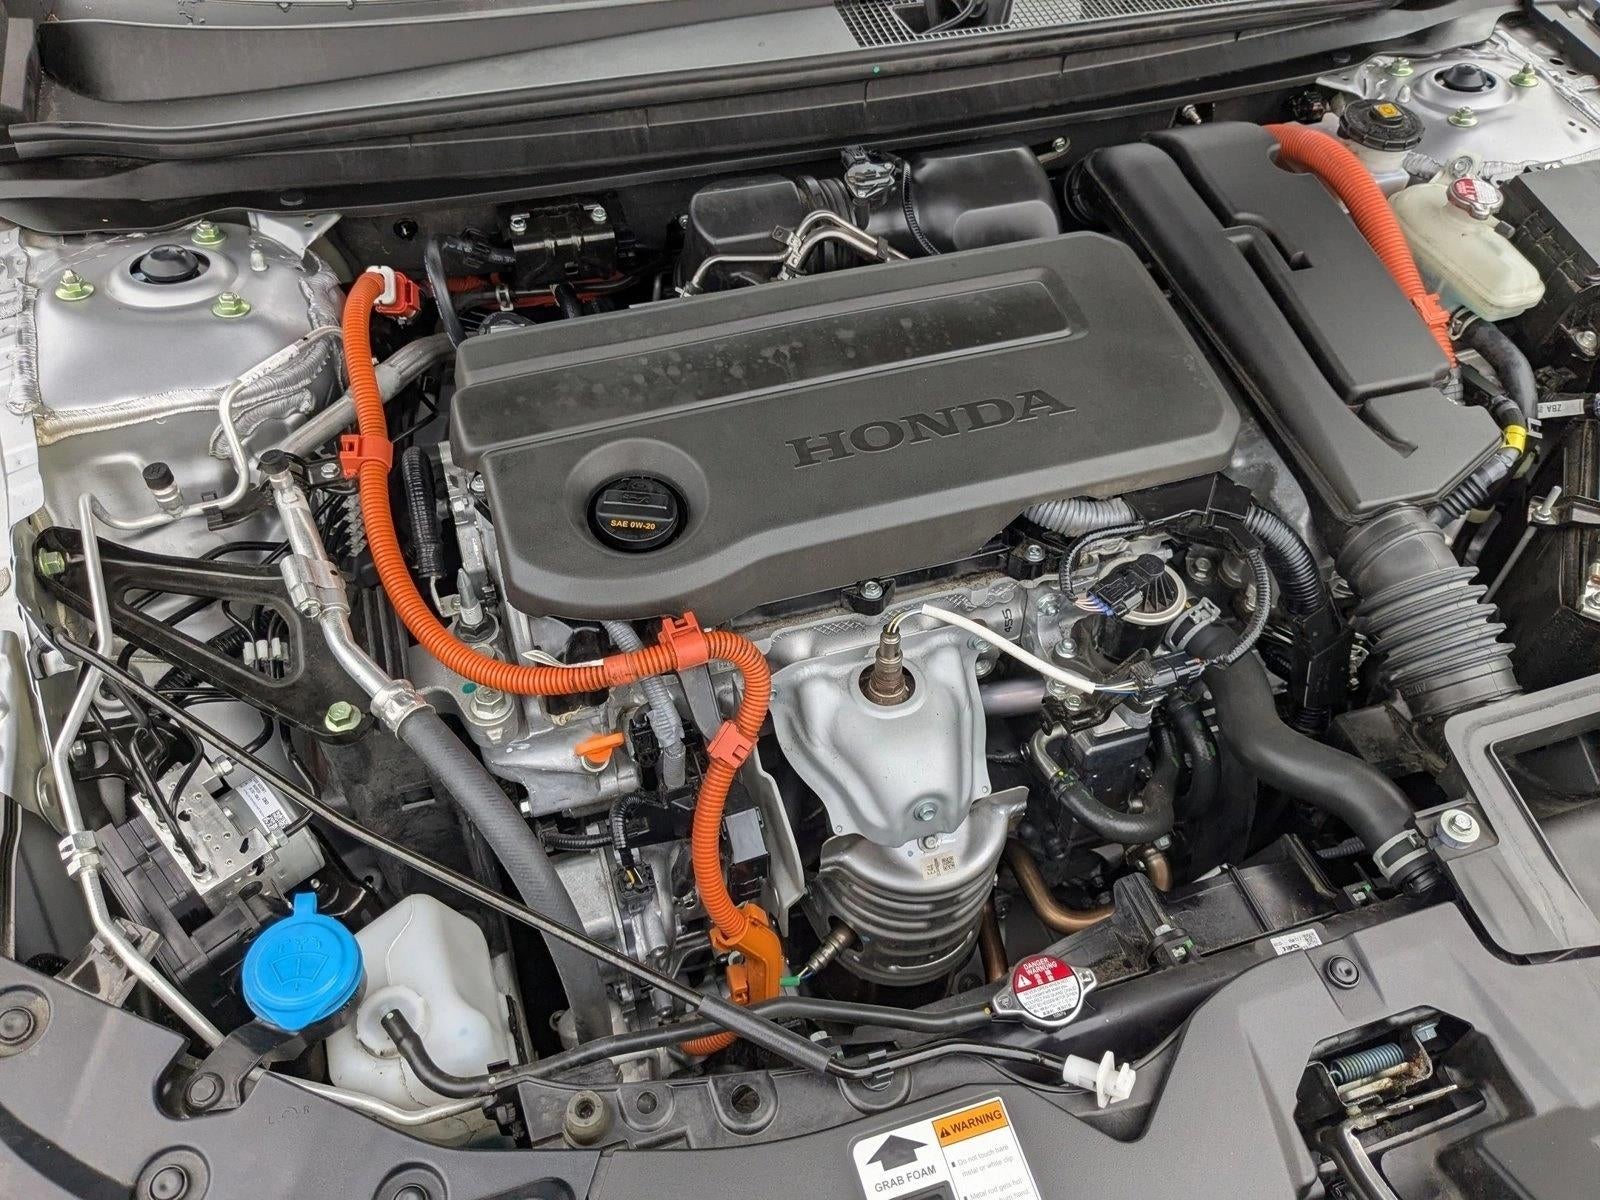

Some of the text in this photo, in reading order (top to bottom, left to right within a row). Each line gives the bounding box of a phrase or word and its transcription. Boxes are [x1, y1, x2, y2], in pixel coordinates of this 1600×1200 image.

[785, 389, 1076, 469] HONDA
[610, 520, 656, 530] SAE 0W-20
[1023, 957, 1048, 970] DANGER
[949, 1110, 1002, 1134] WARNING
[874, 1164, 937, 1193] GRAB FOAM
